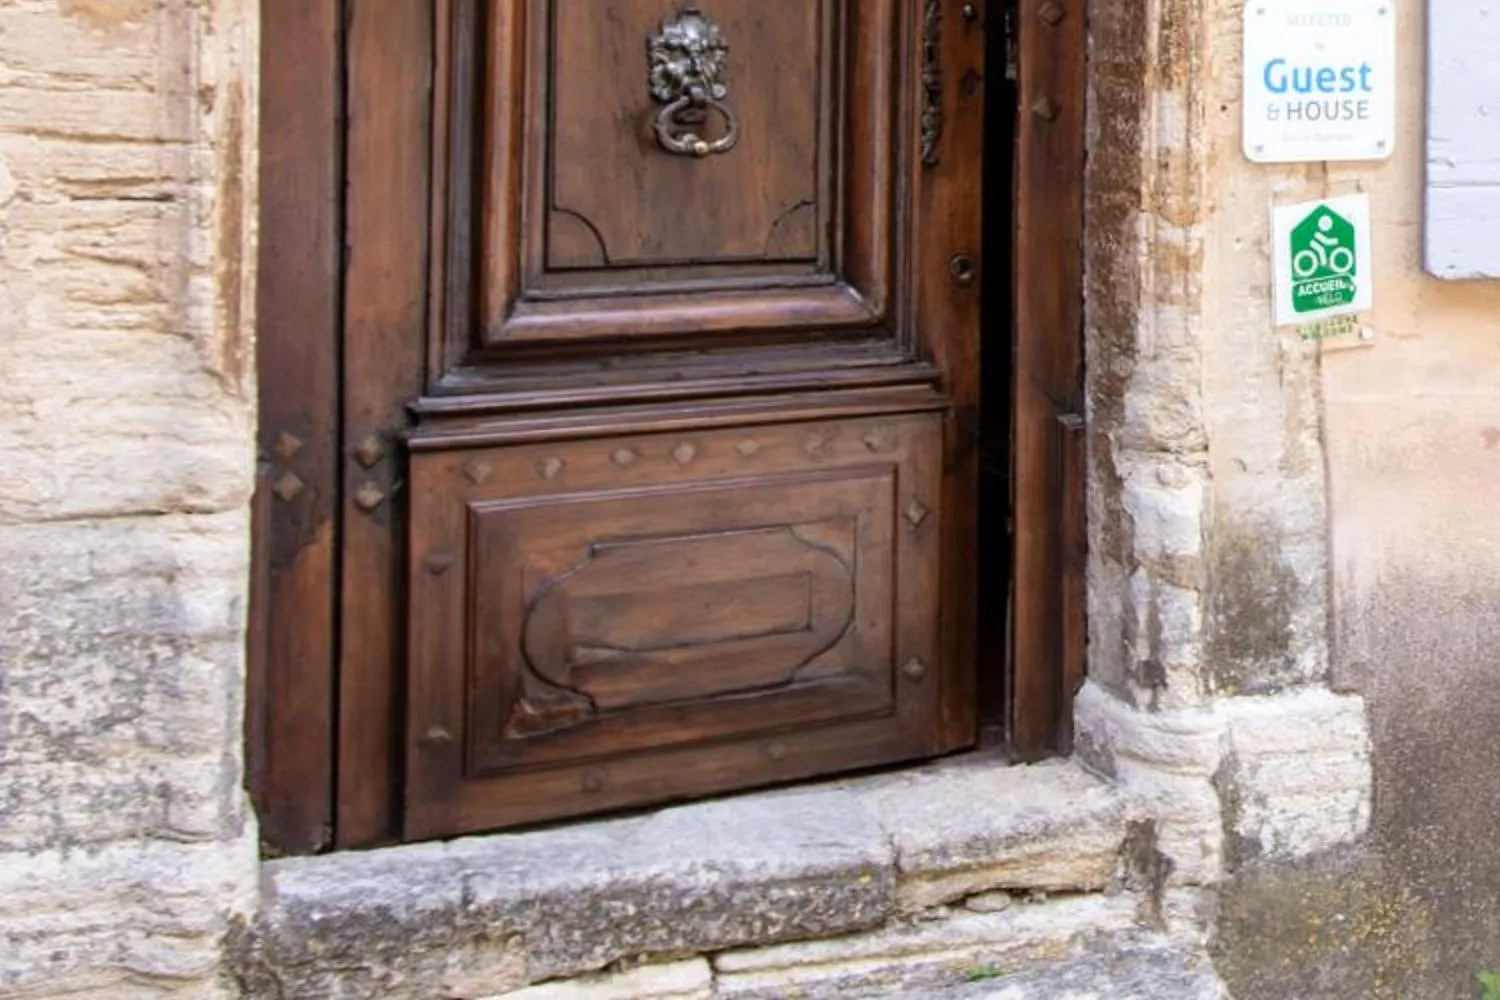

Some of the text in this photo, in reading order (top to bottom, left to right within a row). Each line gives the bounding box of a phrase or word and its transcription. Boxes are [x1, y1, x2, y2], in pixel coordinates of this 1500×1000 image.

[1263, 57, 1373, 94] Guest
[1266, 99, 1370, 121] & HOUSE
[1297, 279, 1346, 297] ACCUEIL
